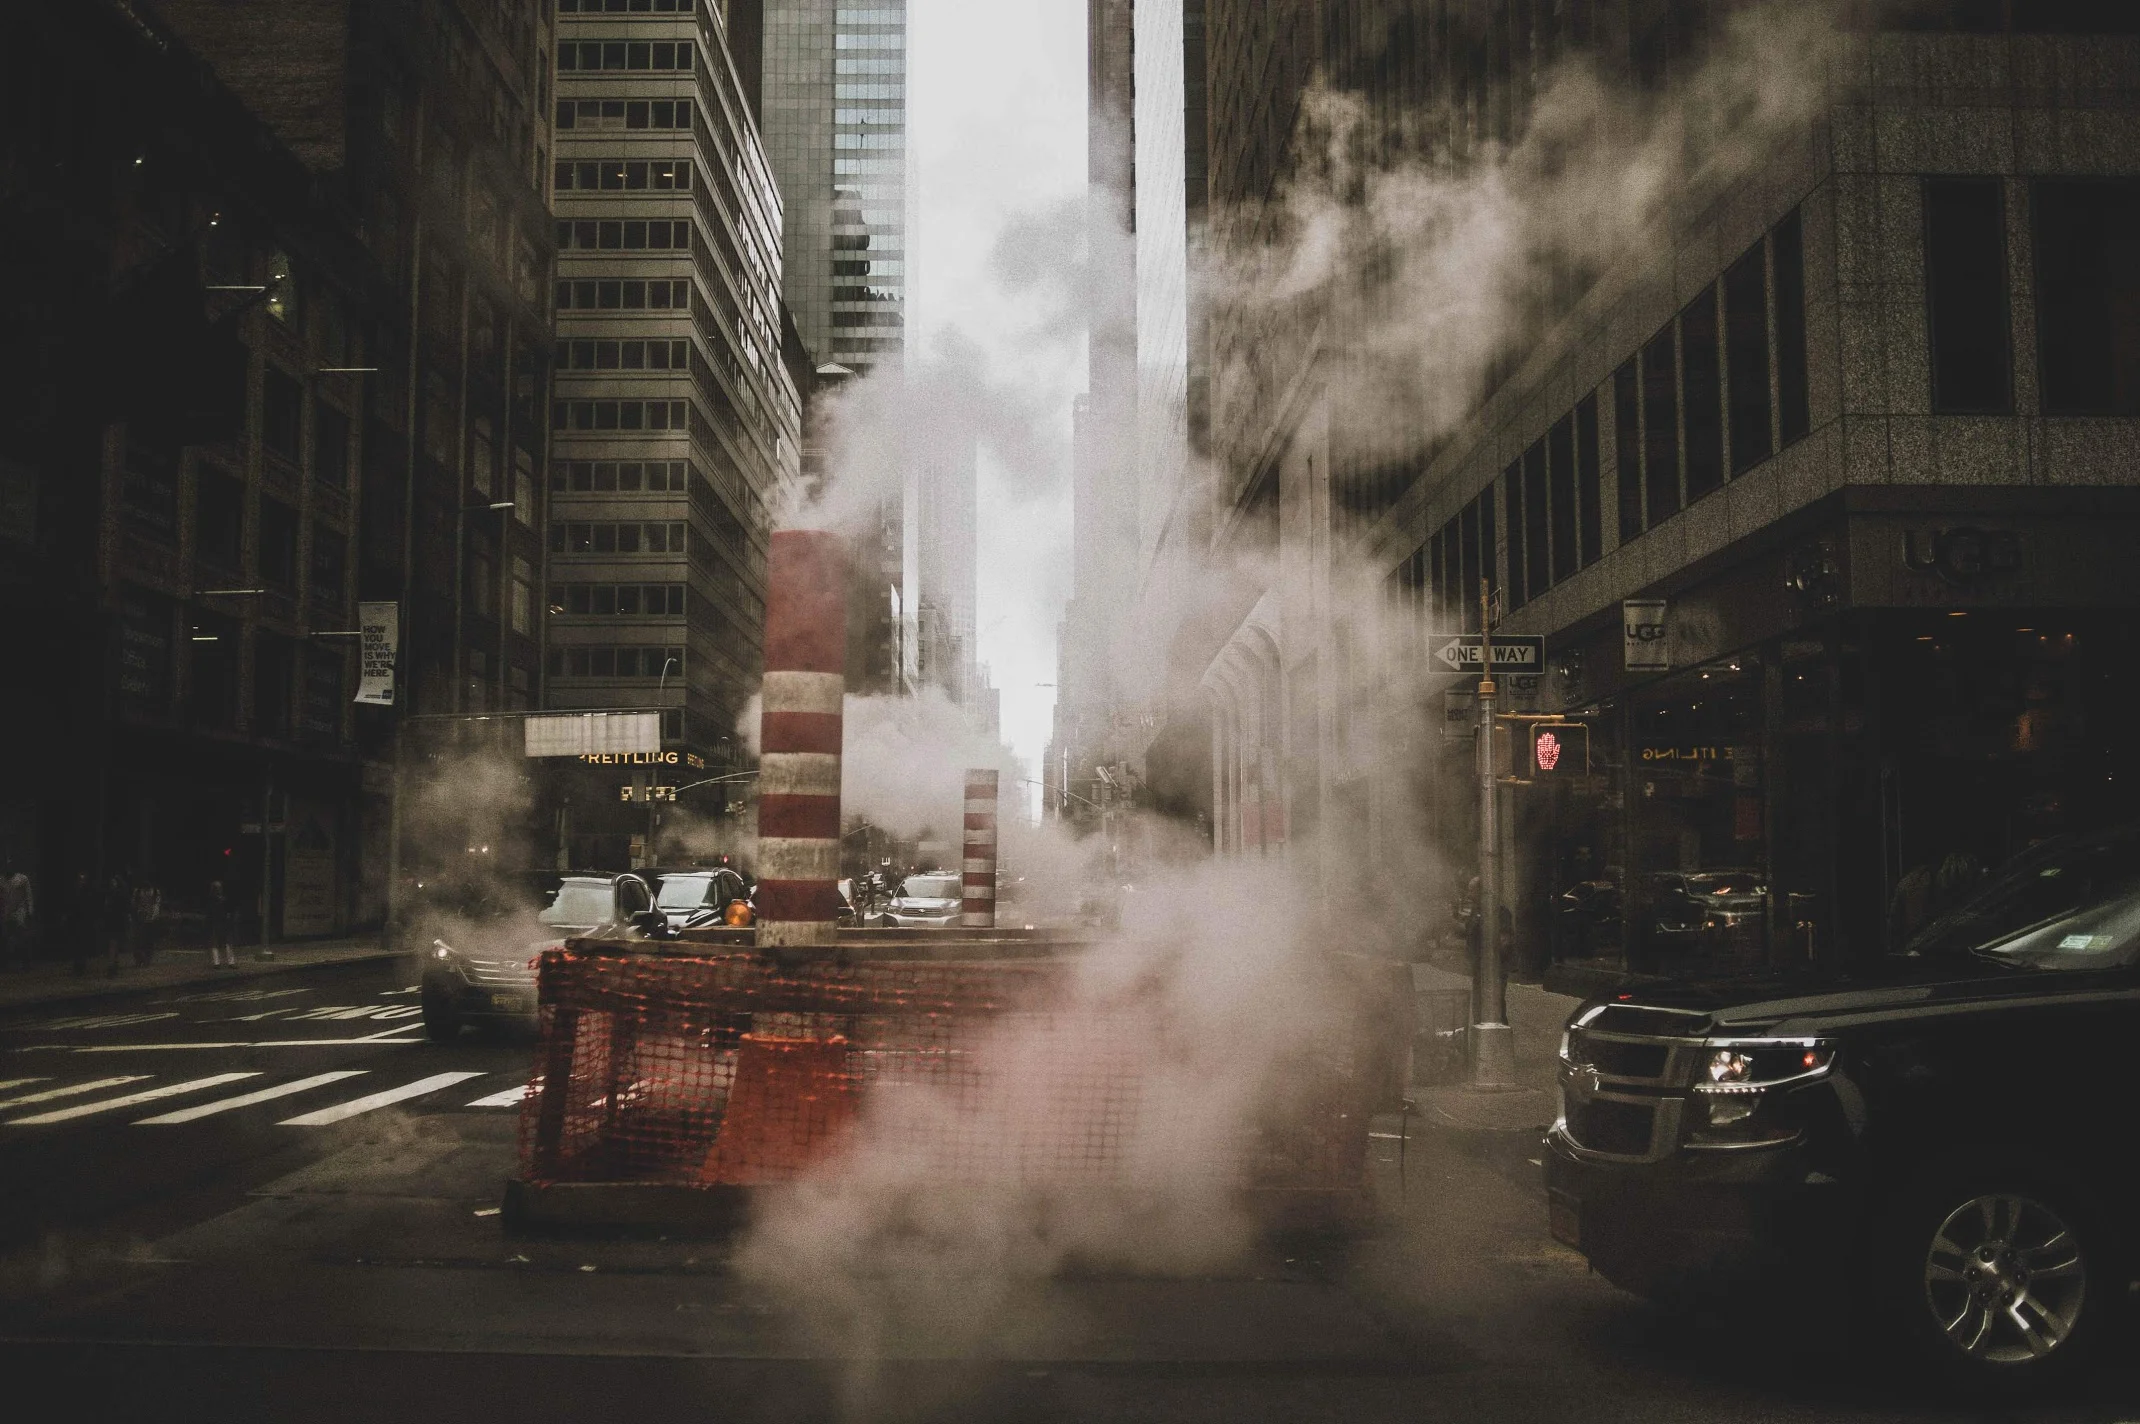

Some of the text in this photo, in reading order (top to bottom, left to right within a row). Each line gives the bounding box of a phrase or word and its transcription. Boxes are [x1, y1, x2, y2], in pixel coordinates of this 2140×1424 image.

[363, 625, 386, 633] HOW
[1627, 624, 1666, 641] UGG
[364, 634, 383, 642] YOU
[376, 652, 396, 660] WHY
[1447, 648, 1529, 662] ONE WAY
[579, 752, 679, 764] REITLING
